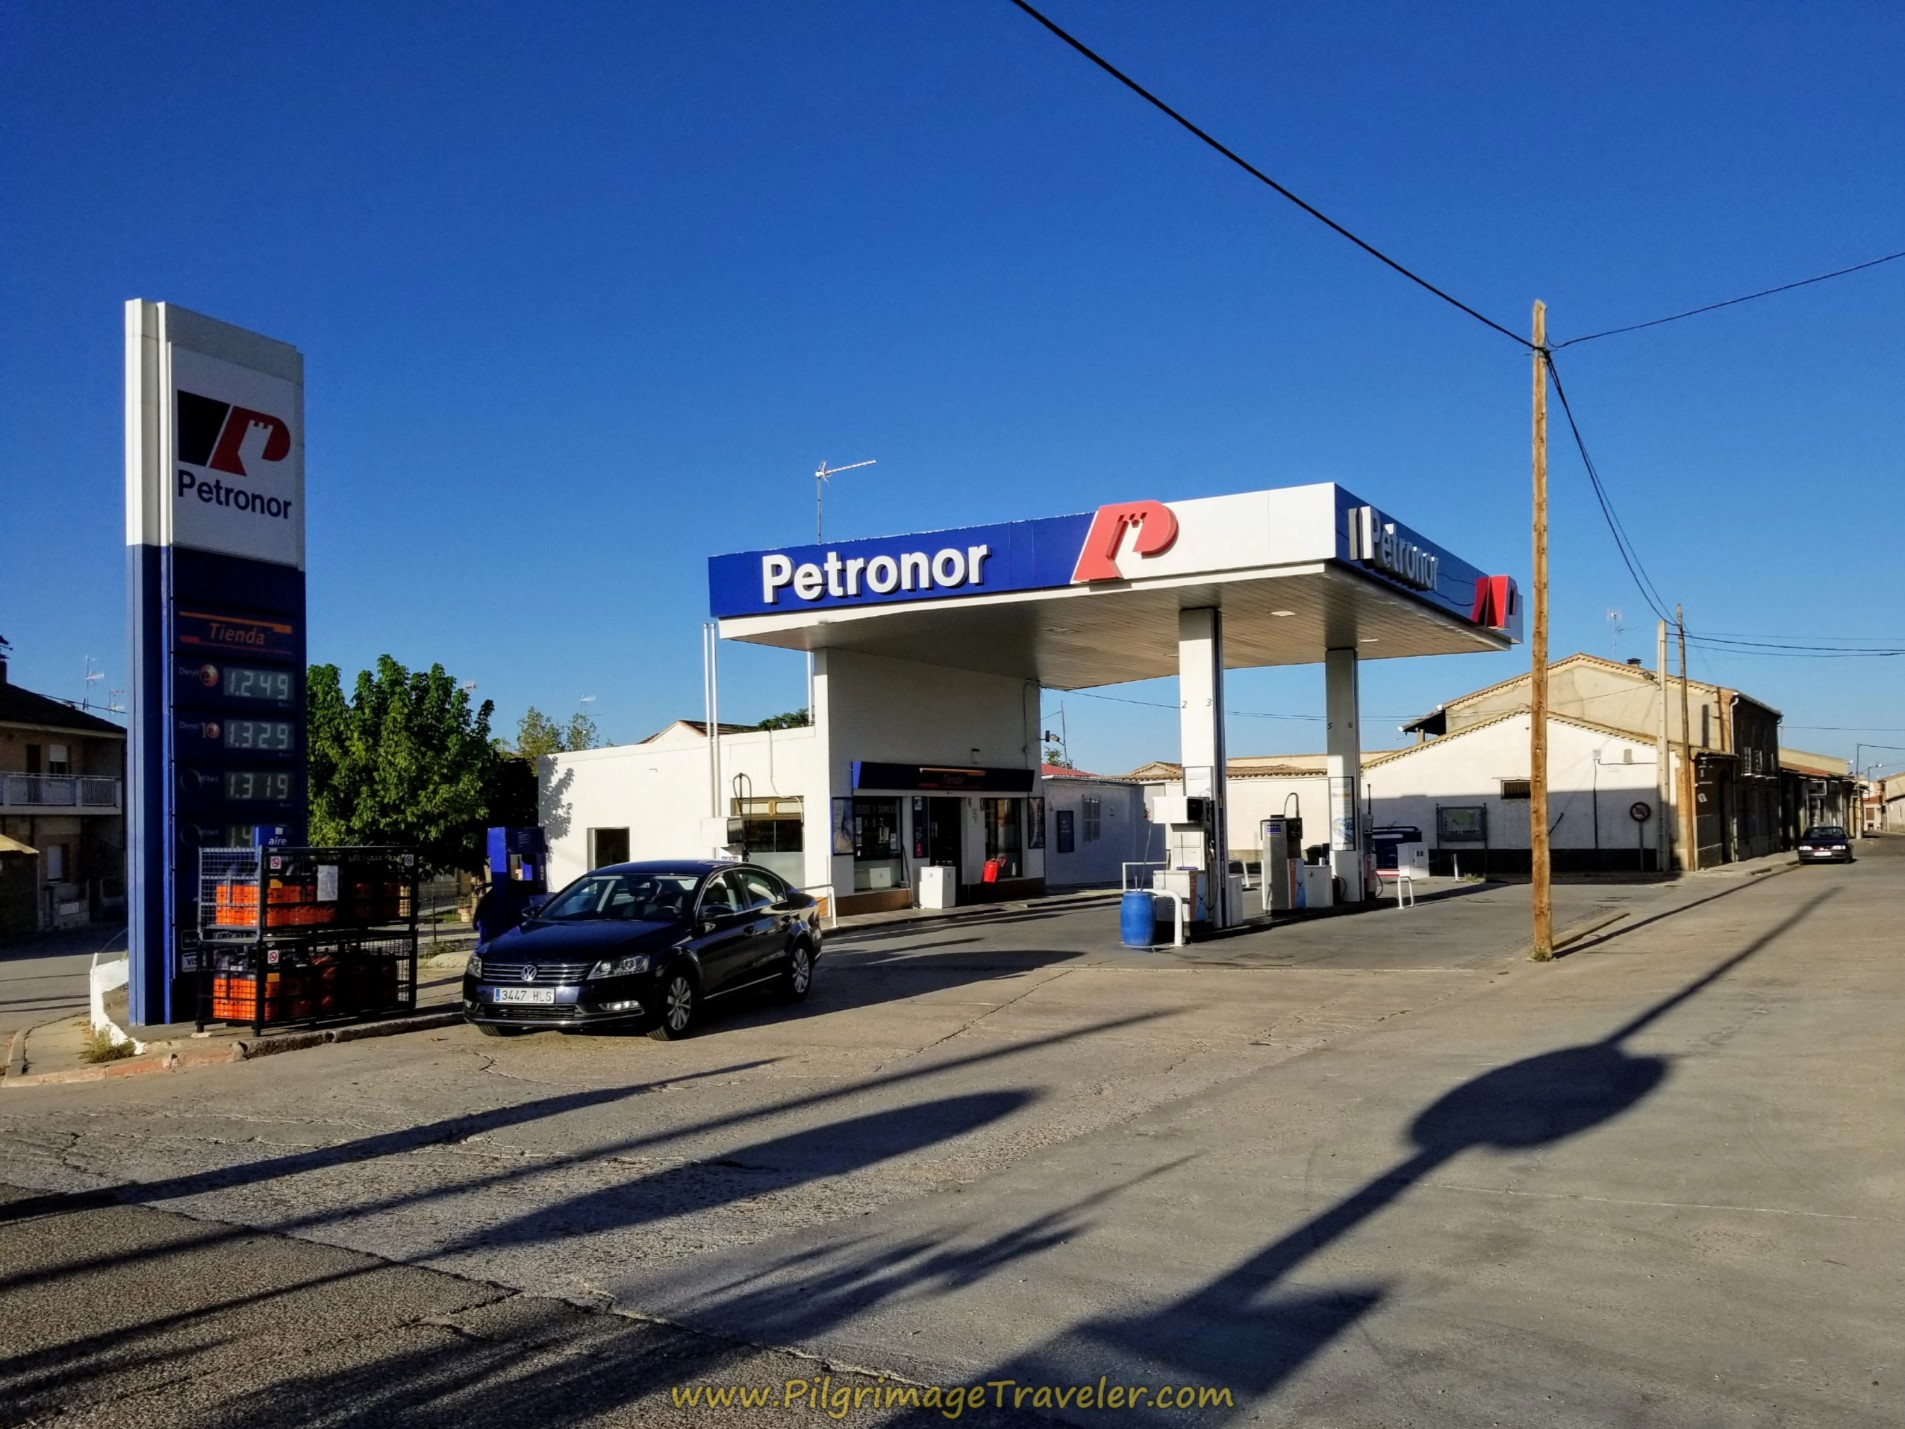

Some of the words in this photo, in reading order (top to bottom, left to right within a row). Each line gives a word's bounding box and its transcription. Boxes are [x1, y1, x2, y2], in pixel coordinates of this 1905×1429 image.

[178, 469, 292, 520] Petronor
[1359, 506, 1439, 591] Petronor
[761, 543, 991, 604] Petronor
[208, 622, 266, 645] Tienda
[229, 671, 289, 700] 1.249
[1181, 700, 1188, 709] 2
[1205, 698, 1212, 707] 3
[229, 723, 289, 748] 1.329
[229, 774, 289, 799] 1.319
[267, 835, 288, 846] aire
[186, 958, 198, 966] VIS
[502, 990, 528, 1002] 3447
